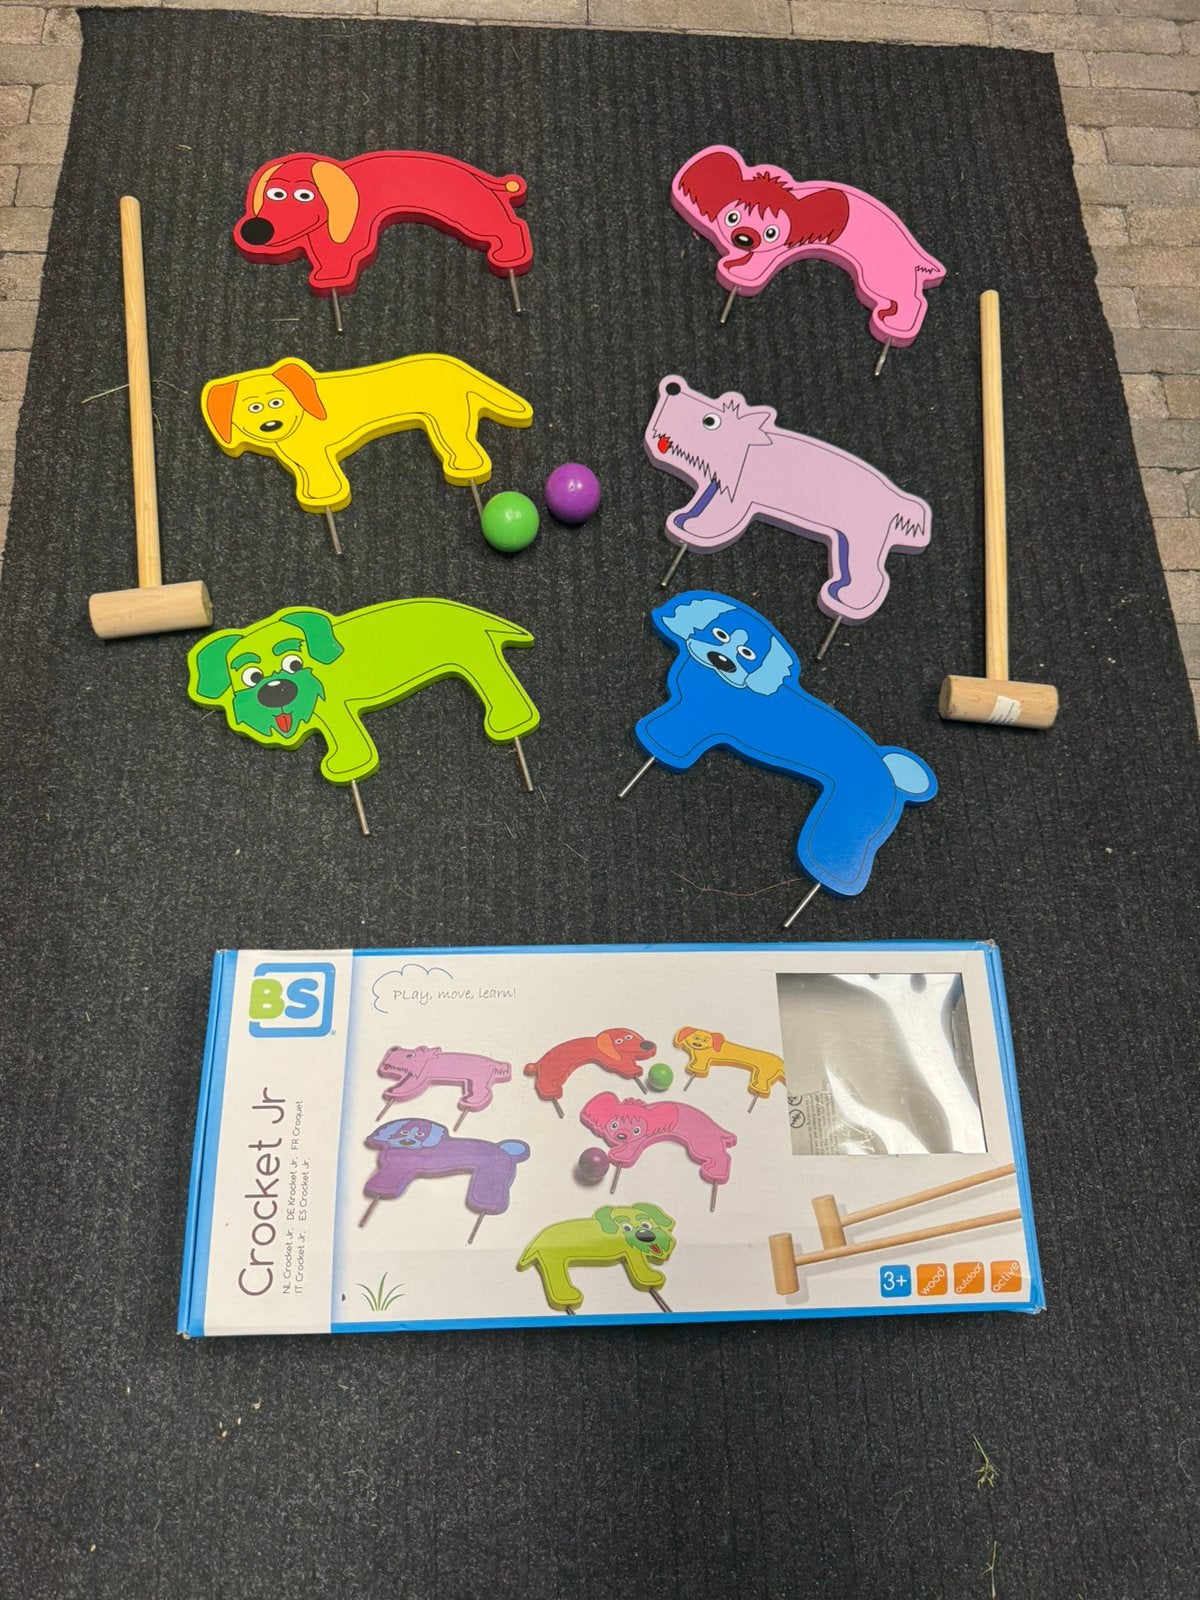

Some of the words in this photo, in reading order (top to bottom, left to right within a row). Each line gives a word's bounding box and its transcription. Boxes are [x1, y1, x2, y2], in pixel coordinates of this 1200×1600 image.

[248, 977, 321, 1020] BS
[437, 989, 475, 1001] move,
[478, 987, 517, 999] learn!
[251, 1086, 286, 1125] Jr
[292, 1100, 304, 1137] Croquet
[290, 1138, 300, 1150] FR
[289, 1156, 299, 1169] Jr.
[301, 1156, 311, 1169] Jr.
[287, 1170, 298, 1206] Krocket
[299, 1171, 310, 1208] Crocket
[237, 1137, 282, 1297] Crocket
[286, 1208, 296, 1221] DE
[298, 1209, 308, 1221] ES
[285, 1227, 295, 1240] Jr.
[297, 1230, 307, 1243] Jr.
[283, 1241, 293, 1279] Crocket
[295, 1245, 306, 1283] Crocket
[282, 1281, 291, 1294] NL
[882, 1270, 908, 1291] 3+
[920, 1266, 946, 1295] wood
[955, 1262, 982, 1294] outdoor
[992, 1261, 1020, 1292] active
[294, 1285, 304, 1294] IT
